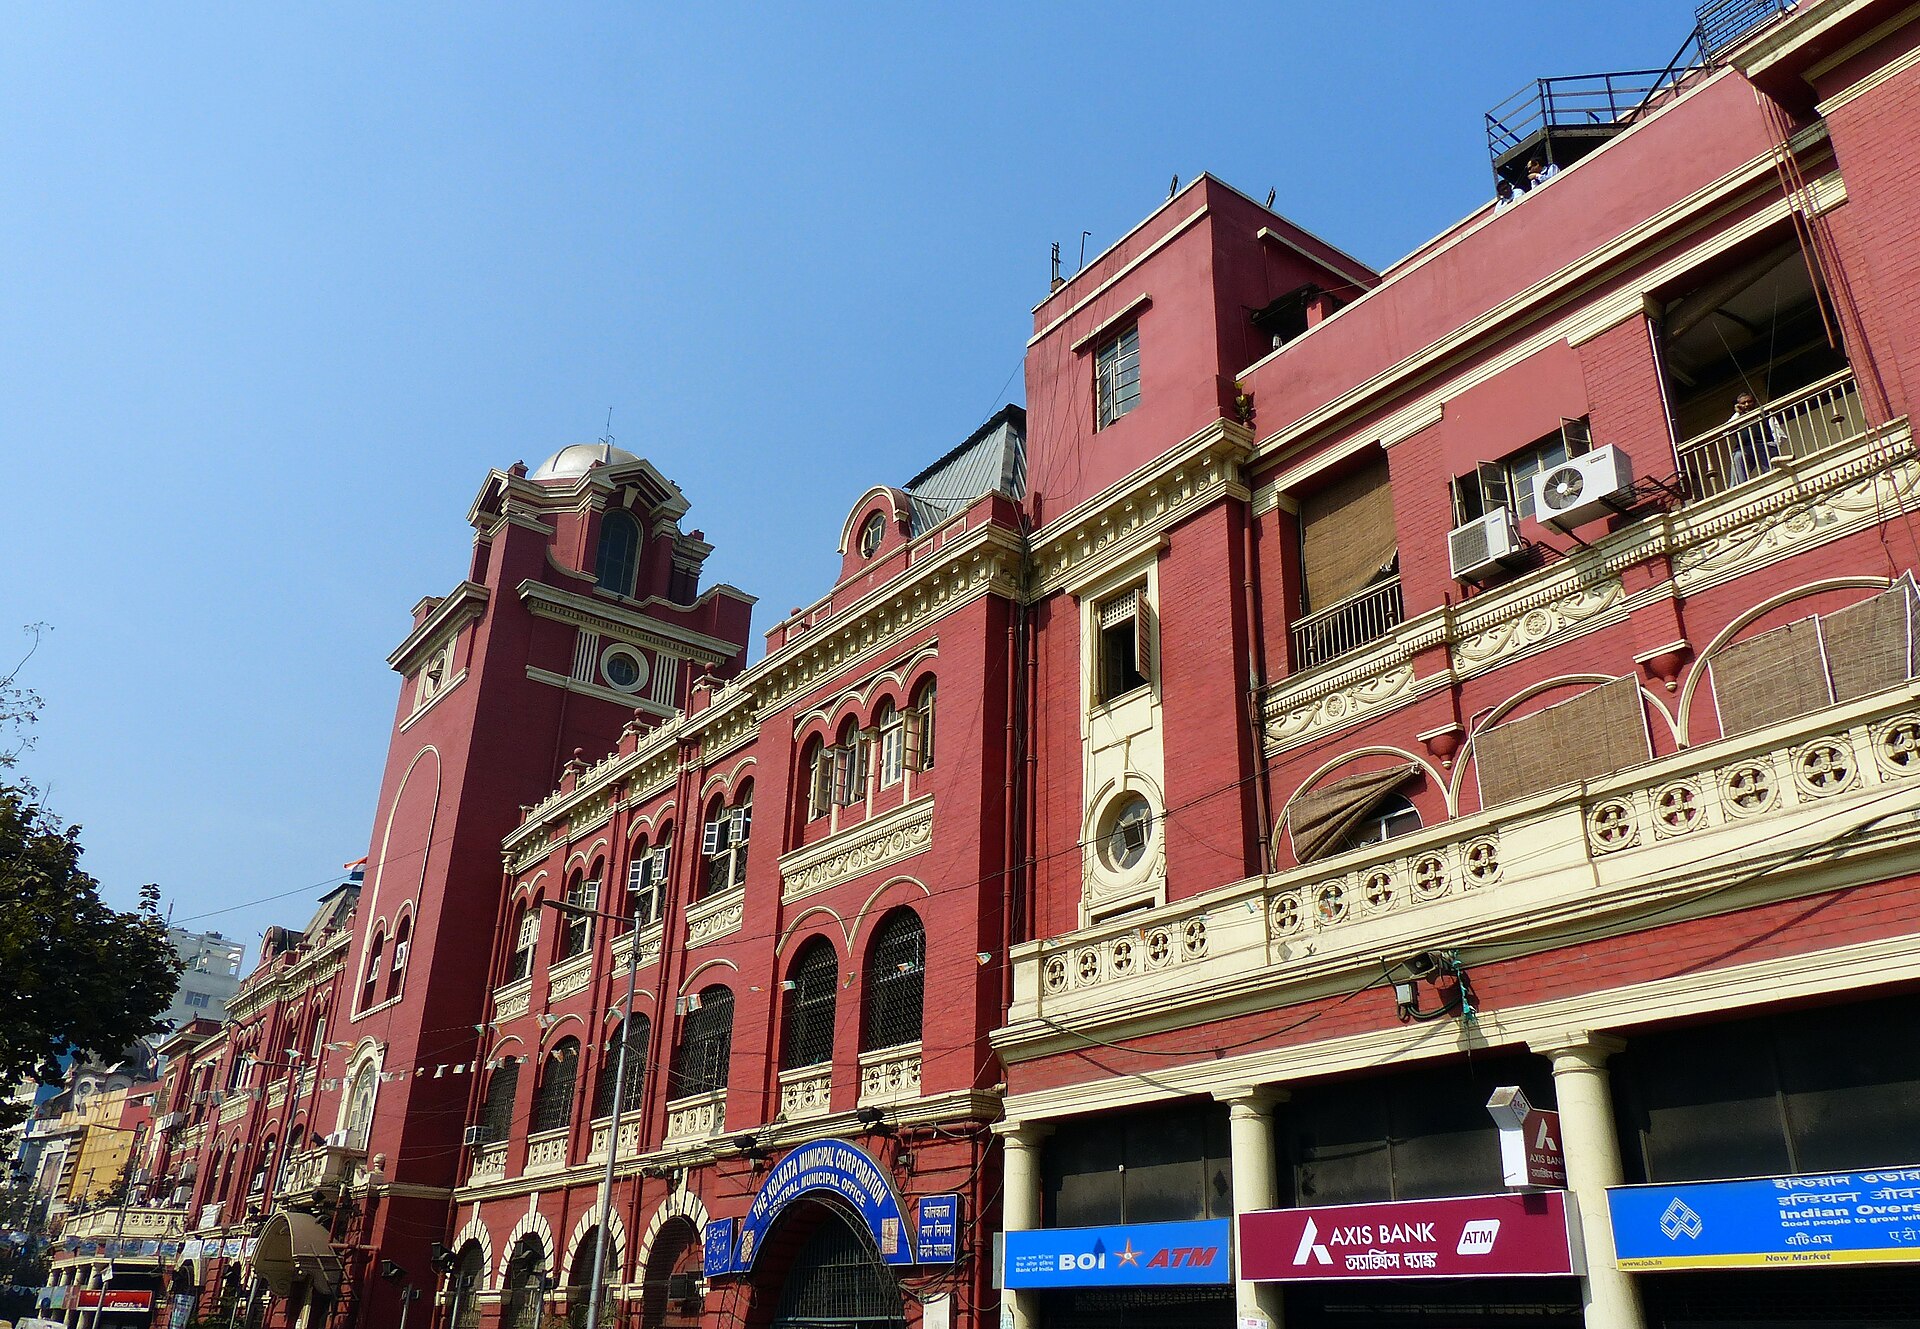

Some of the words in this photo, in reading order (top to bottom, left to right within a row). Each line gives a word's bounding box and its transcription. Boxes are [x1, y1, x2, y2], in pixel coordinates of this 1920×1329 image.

[1529, 1153, 1546, 1164] AXIS
[1546, 1155, 1562, 1165] BAN
[752, 1191, 768, 1220] THE
[766, 1157, 798, 1201] KOLKATA
[798, 1146, 835, 1173] MUNICIPAL
[835, 1148, 888, 1207] CORPORATION
[801, 1171, 840, 1189] MUNICIPAL
[841, 1178, 866, 1208] OFFICE
[1772, 1175, 1850, 1190] ইন্ডিয়ান
[923, 1201, 950, 1219] कोलकाता
[1779, 1208, 1850, 1220] Indian
[921, 1225, 934, 1238] नगर
[934, 1219, 952, 1237] निगम
[1781, 1220, 1810, 1228] Good
[1813, 1218, 1851, 1227] people
[1870, 1216, 1899, 1225] grow
[1330, 1225, 1373, 1247] AXIS
[1379, 1222, 1437, 1244] BANK
[1462, 1230, 1493, 1245] ATM
[1784, 1232, 1833, 1246] এটিএম
[1059, 1253, 1105, 1270] BOI
[1146, 1247, 1218, 1267] ATM
[1345, 1248, 1400, 1271] অ্যাক্সিস
[1765, 1254, 1789, 1262] New
[1792, 1253, 1831, 1261] Market
